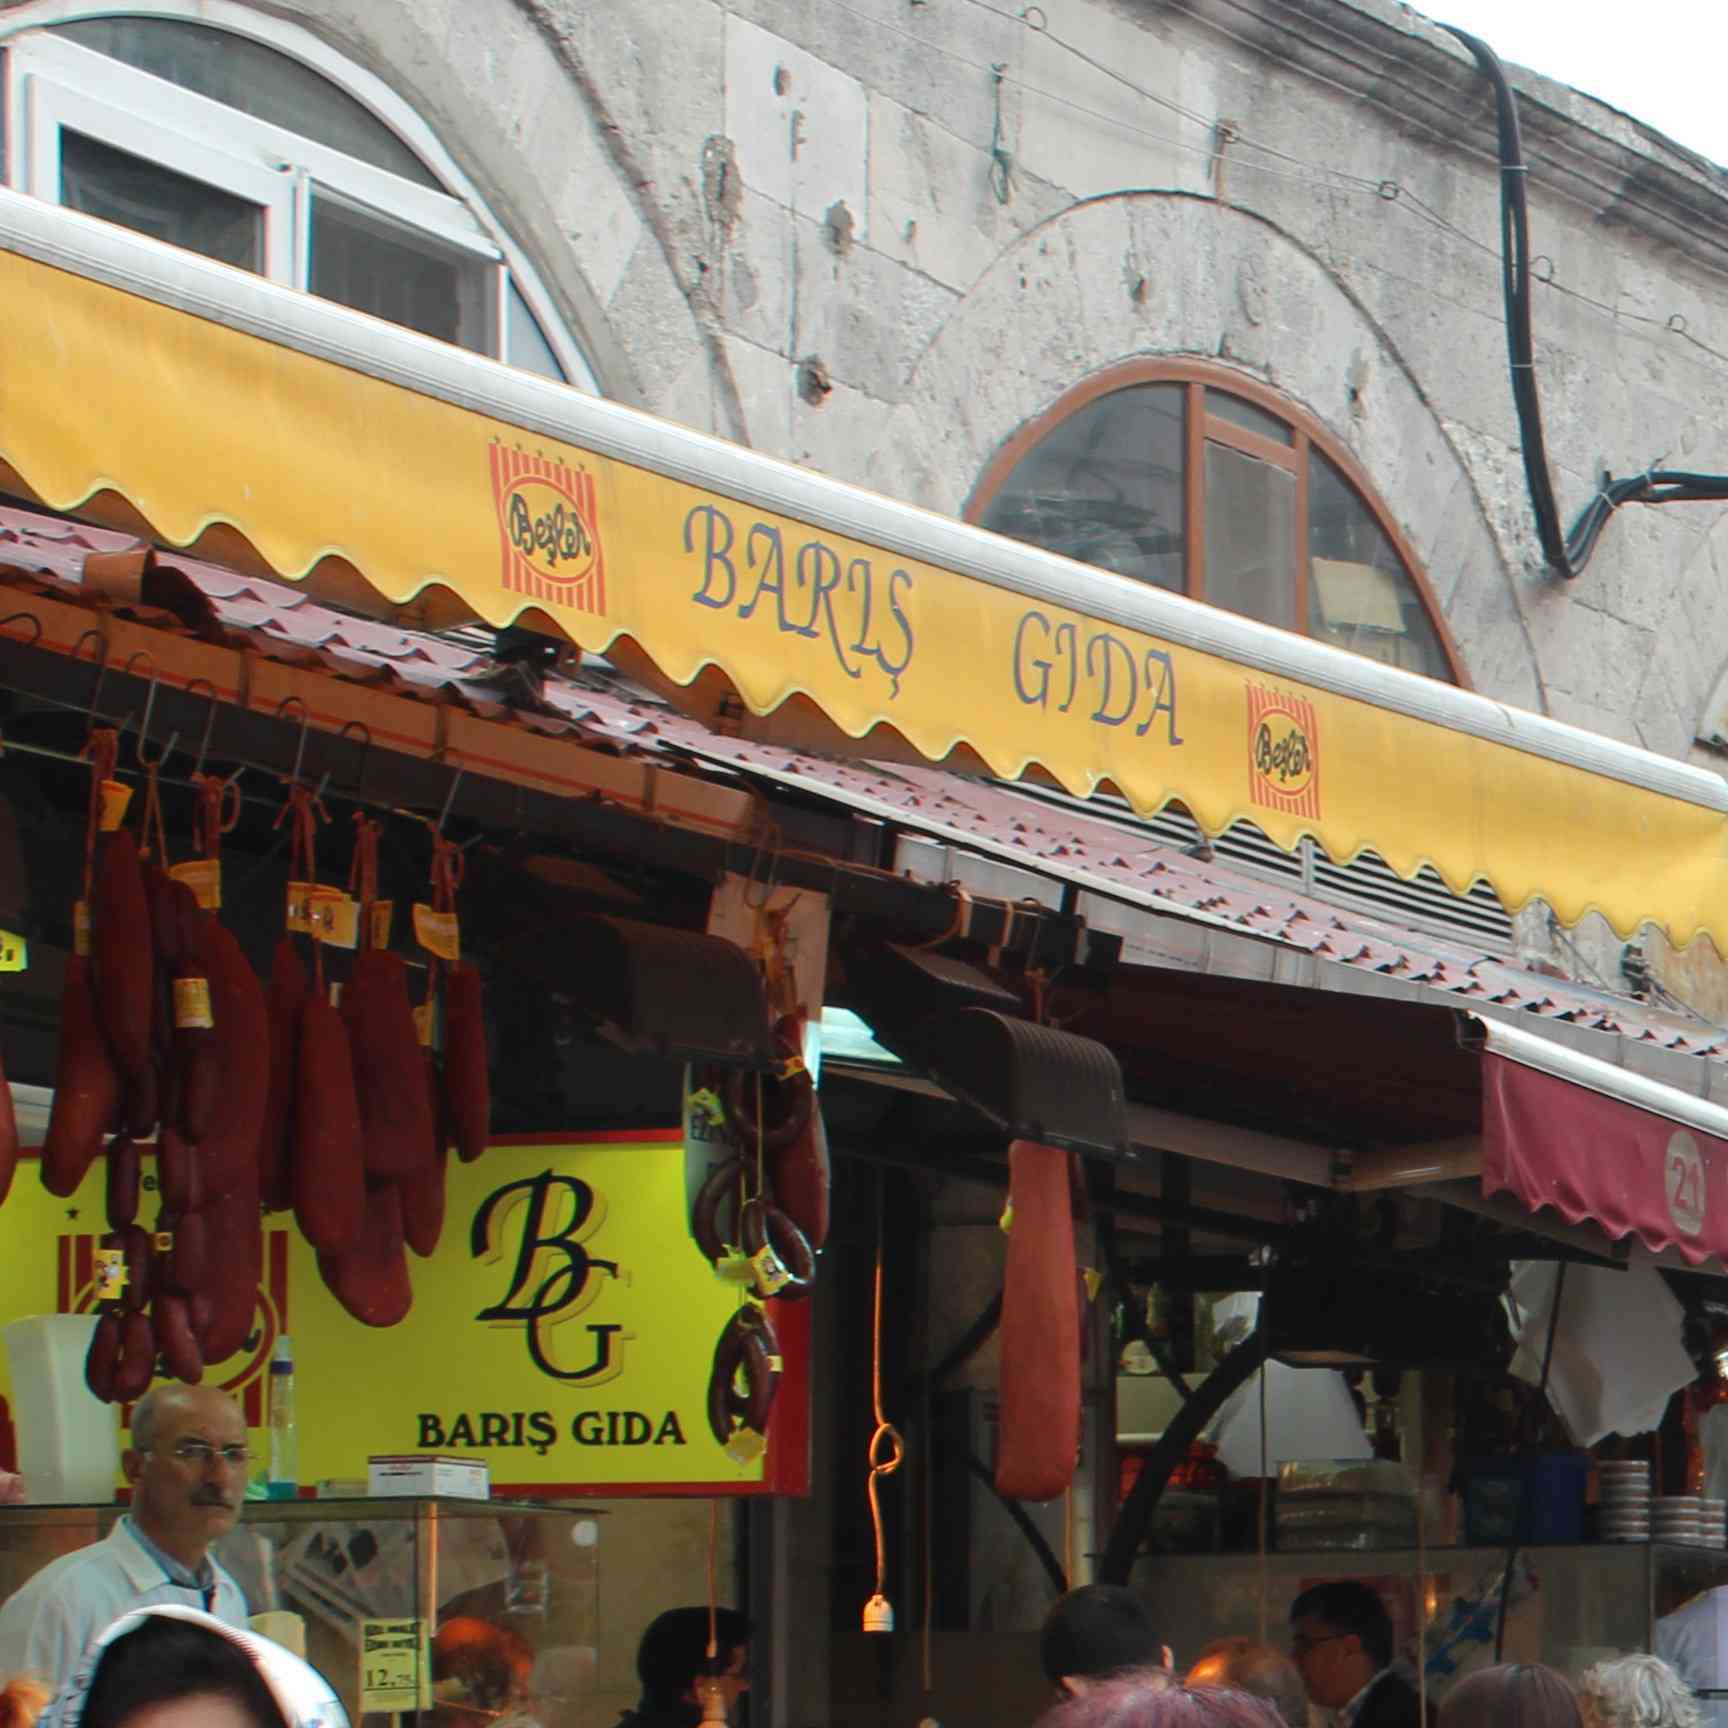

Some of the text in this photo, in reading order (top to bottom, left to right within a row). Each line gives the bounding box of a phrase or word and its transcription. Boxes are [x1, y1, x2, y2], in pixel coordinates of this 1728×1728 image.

[682, 503, 1184, 747] BARIŞ GIDA
[416, 1410, 687, 1455] BARIŞ GIDA
